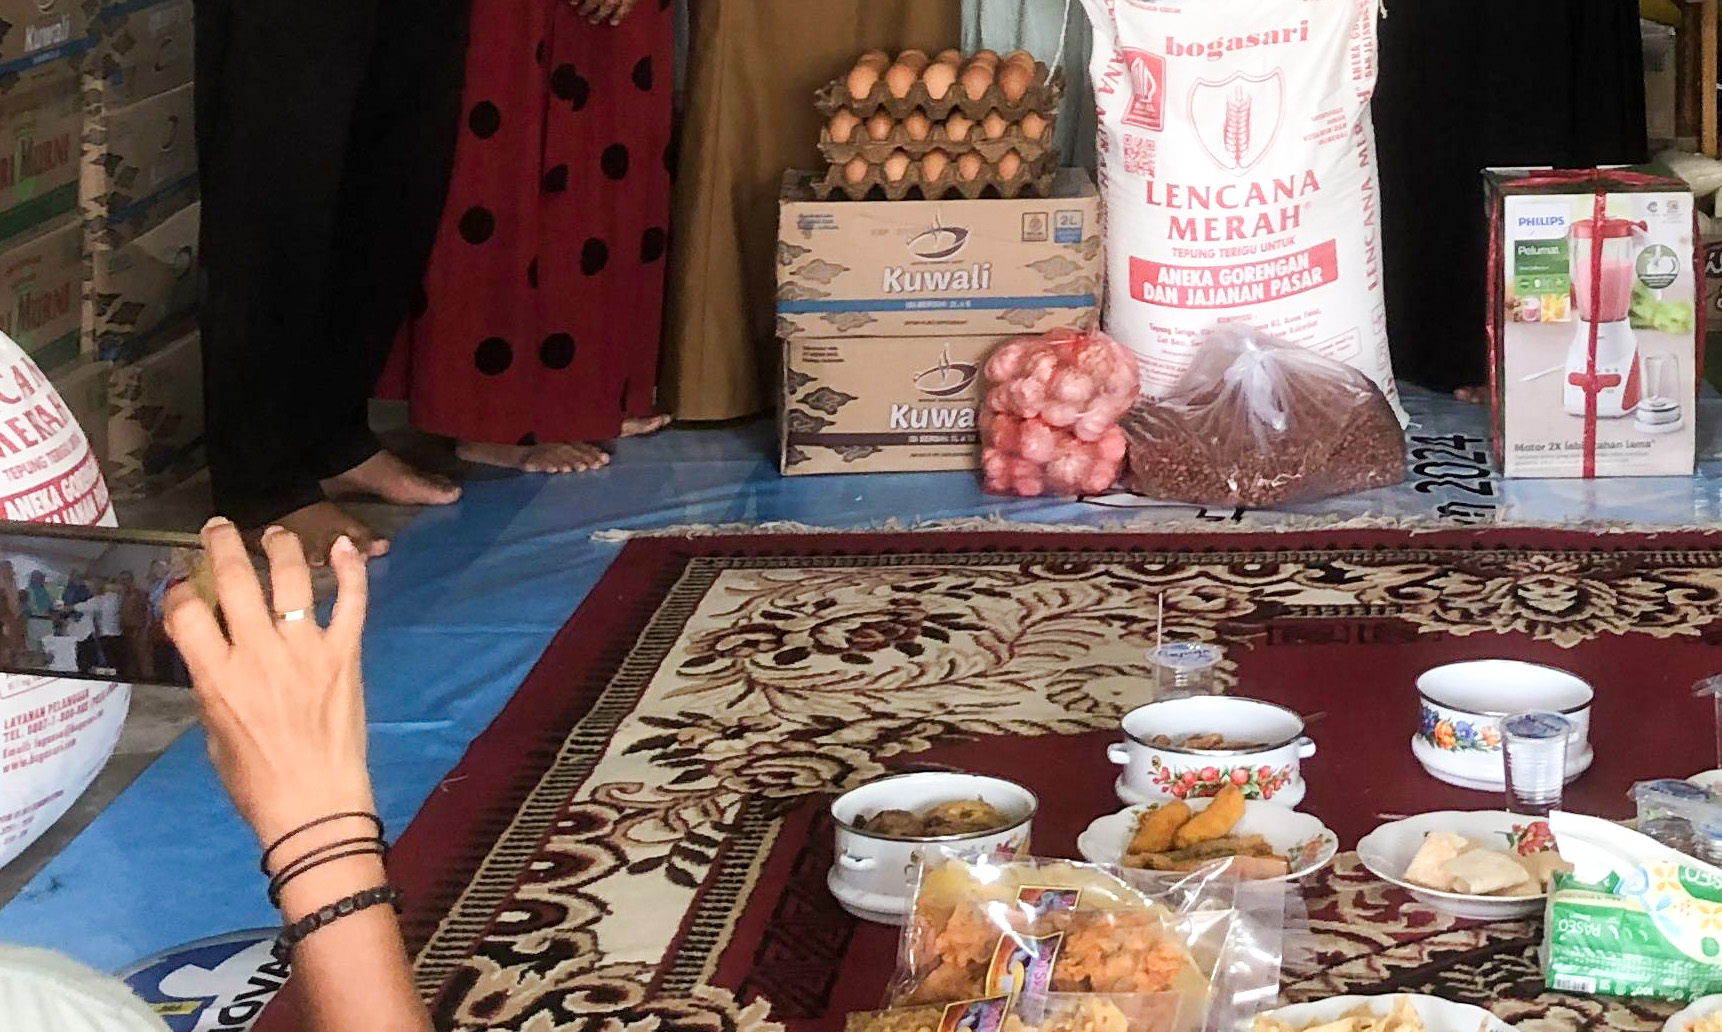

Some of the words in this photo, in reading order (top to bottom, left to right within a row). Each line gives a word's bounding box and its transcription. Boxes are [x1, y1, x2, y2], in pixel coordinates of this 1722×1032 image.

[1165, 20, 1309, 62] bogasari
[1146, 169, 1321, 210] LENCANA
[1167, 205, 1300, 242] MERAH
[1518, 216, 1565, 227] PHILIPS
[1172, 247, 1215, 259] TEPUNG
[1219, 246, 1257, 258] TERIGU
[1260, 235, 1296, 253] UNTUK
[883, 262, 993, 294] Kuwali
[1143, 281, 1179, 303] DAN
[1185, 282, 1265, 306] JAJANAN
[1270, 266, 1324, 297] PASAR
[1158, 266, 1213, 287] ANEKA
[1219, 252, 1310, 286] GORENGAN
[889, 403, 976, 430] Kuwa
[1411, 434, 1494, 496] 2024
[1558, 918, 1602, 939] PASEO
